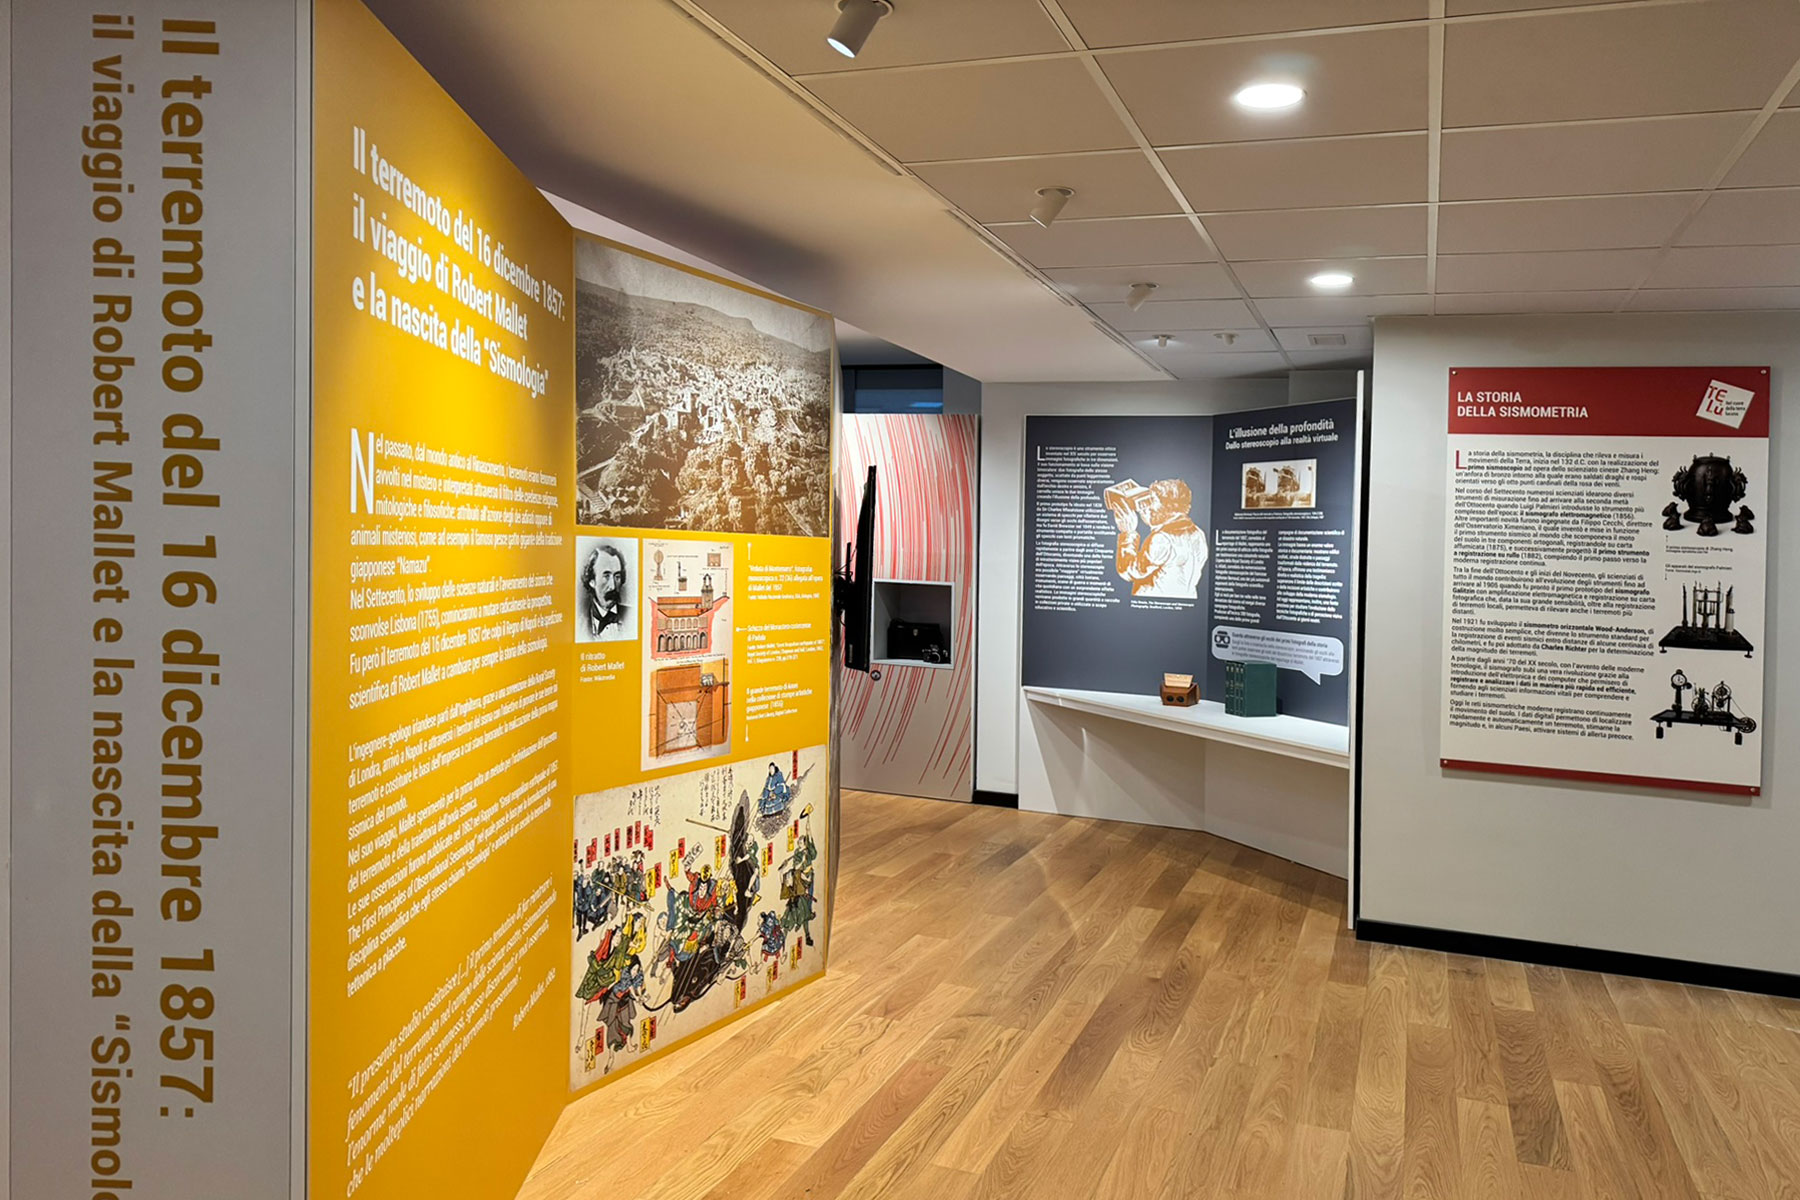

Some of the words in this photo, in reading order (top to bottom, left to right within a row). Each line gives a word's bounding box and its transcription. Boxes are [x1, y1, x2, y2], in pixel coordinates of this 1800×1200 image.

[92, 14, 135, 40] il
[161, 19, 220, 55] Il
[81, 54, 135, 223] viaggio
[161, 75, 213, 393] terremoto
[353, 126, 366, 175] Il
[370, 144, 450, 237] terremoto
[453, 209, 473, 255] del
[476, 227, 491, 268] 16
[493, 241, 540, 303] dicembre
[542, 279, 565, 322] 1857:
[92, 236, 135, 278] di
[353, 192, 365, 243] il
[370, 212, 432, 284] viaggio
[435, 252, 449, 294] di
[452, 262, 492, 321] Robert
[495, 293, 528, 342] Mallet
[352, 275, 365, 310] e
[370, 271, 387, 322] la
[391, 295, 448, 350] nascita
[451, 319, 482, 367] della
[92, 294, 135, 446] Robert
[1457, 391, 1473, 403] LA
[1476, 391, 1522, 403] STORIA
[1457, 406, 1496, 417] DELLA
[1499, 406, 1589, 418] SISMOMETRIA
[1229, 426, 1267, 439] L'illusione
[1268, 424, 1288, 435] della
[1290, 418, 1335, 435] profondità
[1241, 437, 1279, 448] stereoscopio
[1280, 436, 1292, 445] alla
[1293, 434, 1312, 444] realtà
[1312, 433, 1339, 442] virtuale
[161, 412, 221, 507] del
[385, 439, 415, 462] passato,
[415, 441, 426, 461] dal
[426, 448, 448, 466] mondo
[376, 466, 400, 486] avvolti
[401, 468, 412, 488] nel
[413, 470, 437, 491] mistero
[376, 494, 416, 521] mitologiche
[92, 461, 135, 604] Mallet
[350, 524, 381, 546] animali
[382, 525, 418, 547] misteriosi,
[419, 532, 436, 546] come
[161, 534, 218, 608] 16
[350, 555, 396, 584] giapponese
[350, 587, 365, 610] Nel
[366, 586, 407, 608] Settecento,
[407, 583, 414, 602] lo
[415, 581, 440, 604] sviluppo
[442, 579, 456, 598] delle
[92, 617, 123, 643] e
[350, 616, 389, 642] sconvolse
[390, 613, 417, 635] Lisbona
[1523, 621, 1559, 629] sismometro
[1595, 625, 1646, 635] Wood-Anderson,
[92, 658, 135, 696] la
[350, 653, 361, 675] Fu
[362, 647, 380, 677] però
[380, 645, 386, 667] il
[387, 642, 419, 664] terremoto
[420, 636, 431, 656] del
[432, 635, 440, 653] 16
[349, 680, 389, 709] scientifica
[390, 675, 397, 696] di
[398, 670, 421, 693] Robert
[421, 664, 440, 686] Mallet
[91, 711, 134, 876] nascita
[160, 628, 220, 922] dicembre
[91, 889, 134, 999] della
[159, 949, 216, 1119] 1857:
[360, 1037, 397, 1095] presente
[398, 1009, 422, 1046] studio
[345, 1070, 389, 1142] fenomeni
[390, 1053, 402, 1085] del
[404, 1018, 440, 1069] terremoto
[90, 1014, 133, 1200] "Sismol
